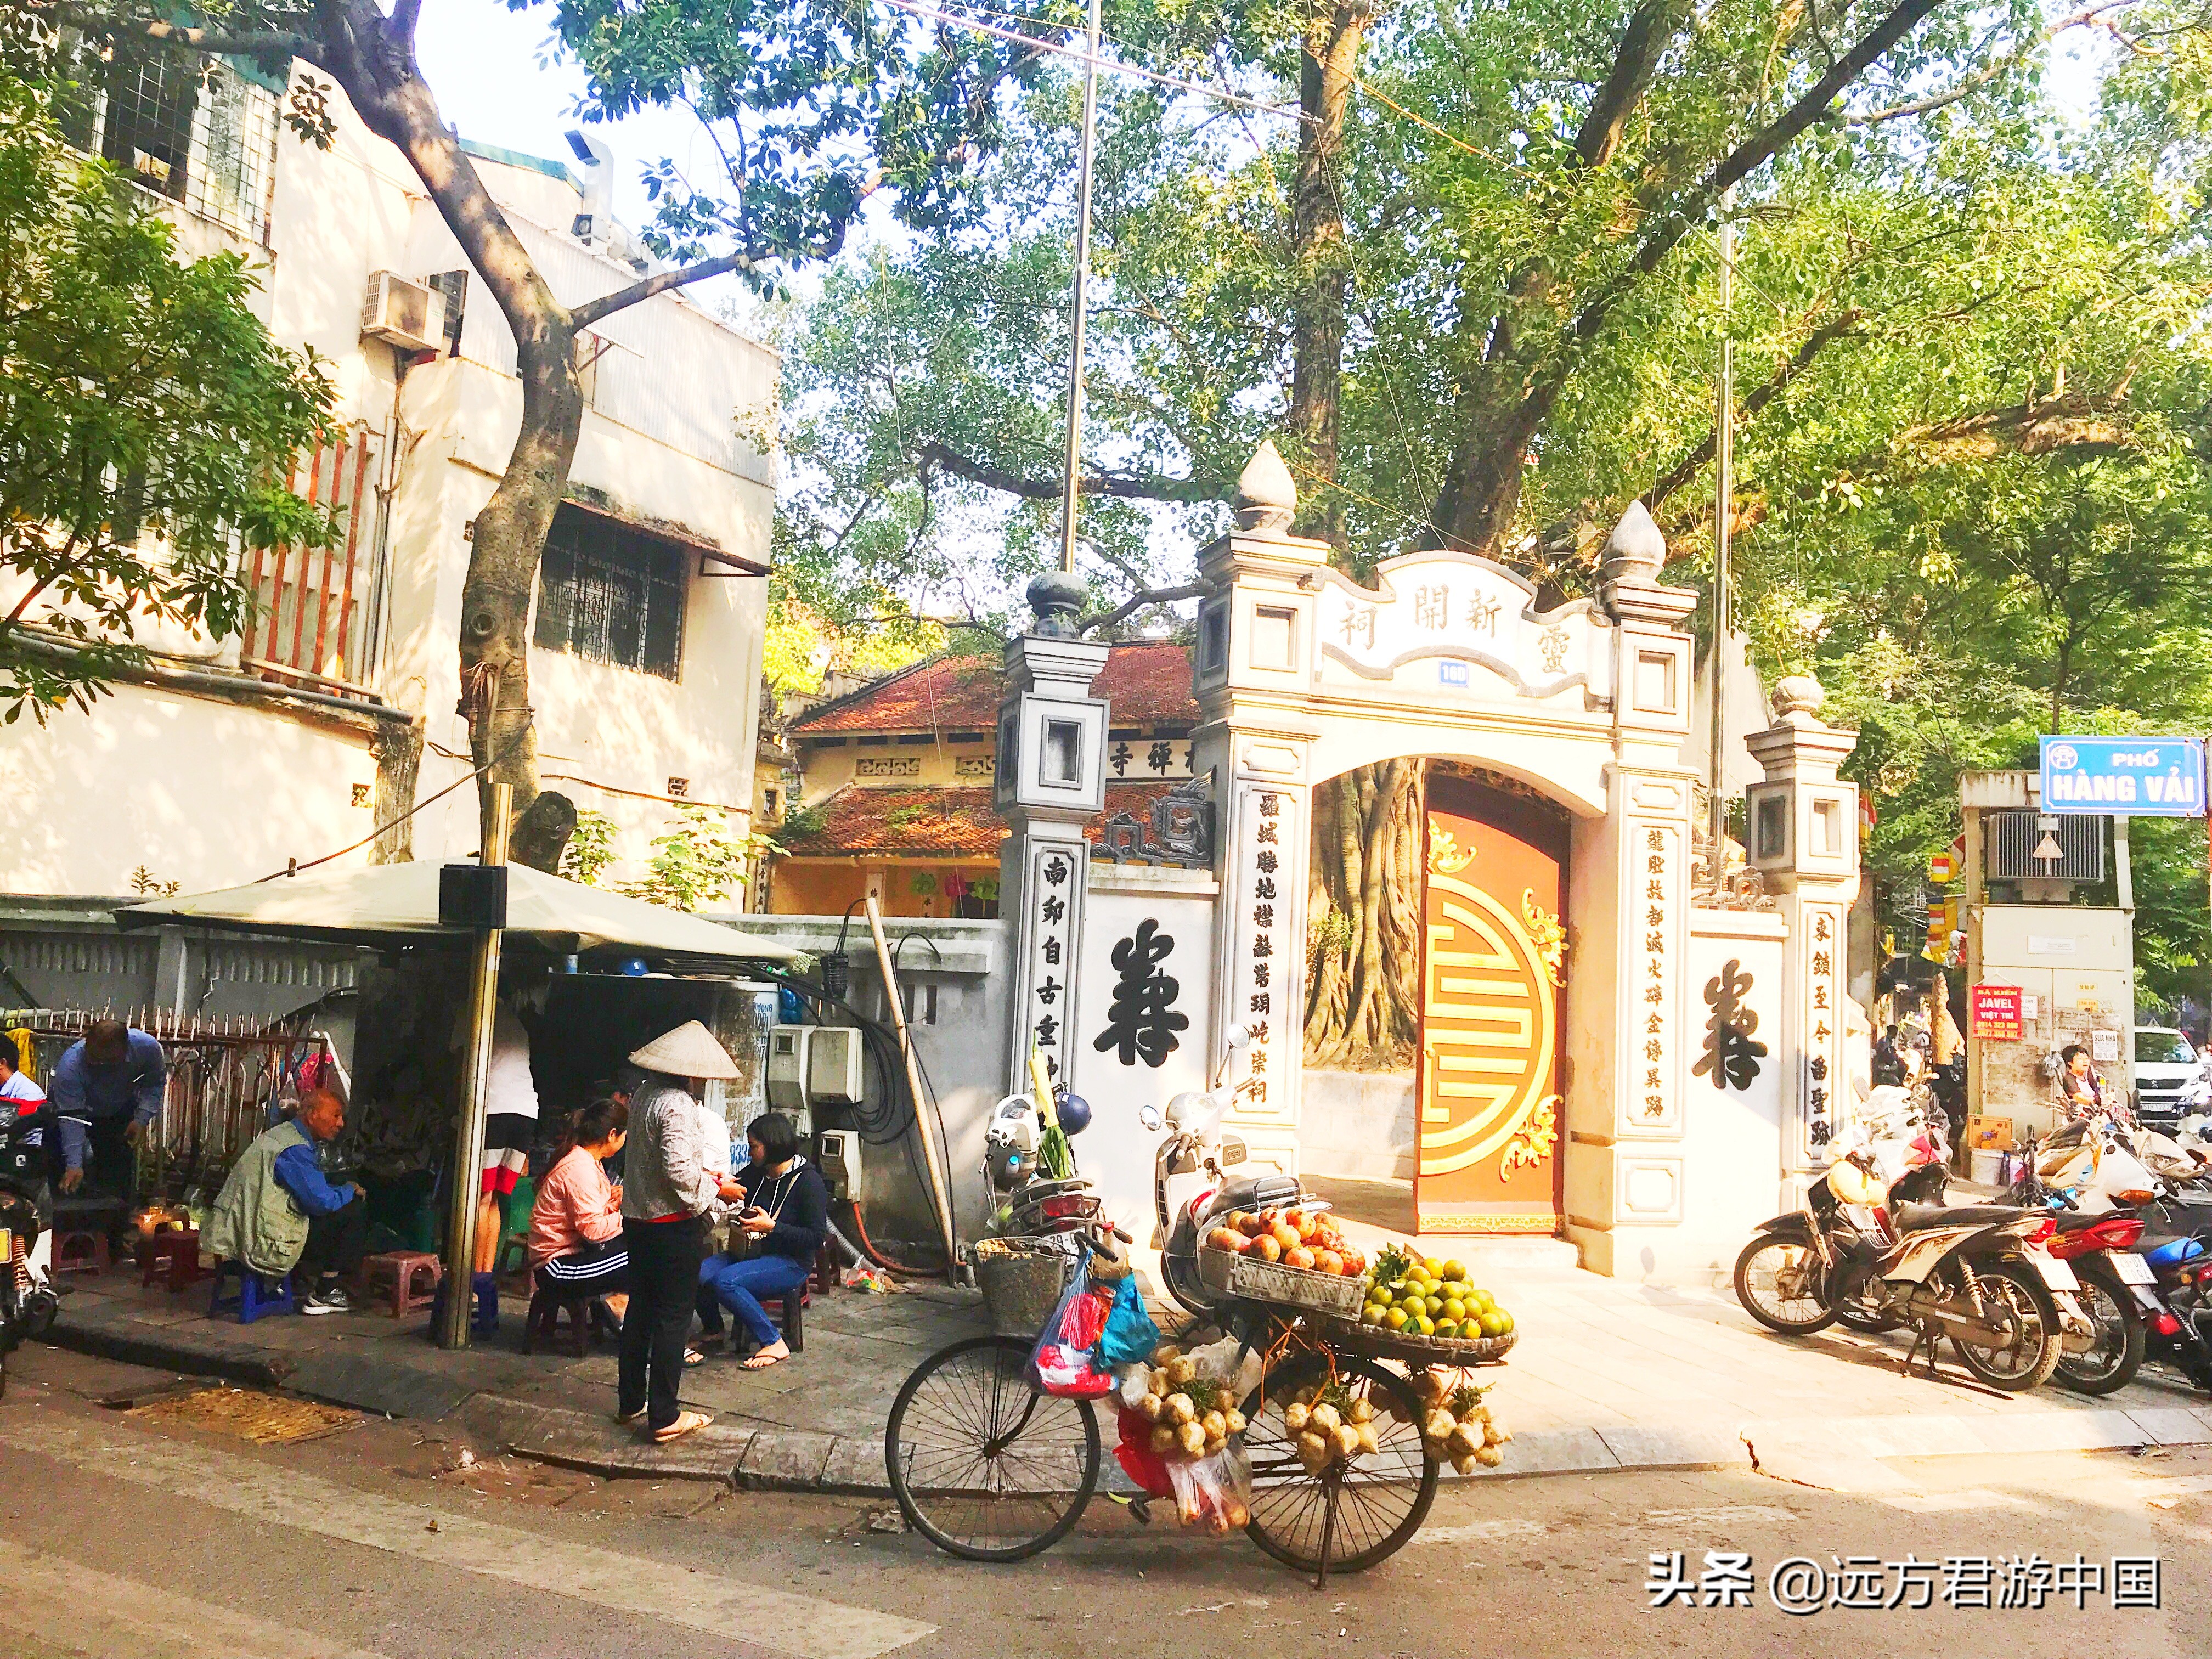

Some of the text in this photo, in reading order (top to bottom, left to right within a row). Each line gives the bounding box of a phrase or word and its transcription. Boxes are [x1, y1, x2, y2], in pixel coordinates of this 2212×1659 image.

[2112, 748, 2160, 767] PHỐ
[2052, 766, 2195, 803] HÀNG VẢI
[1978, 998, 2015, 1009] JAVEL
[1980, 1010, 1999, 1020] VIỆT
